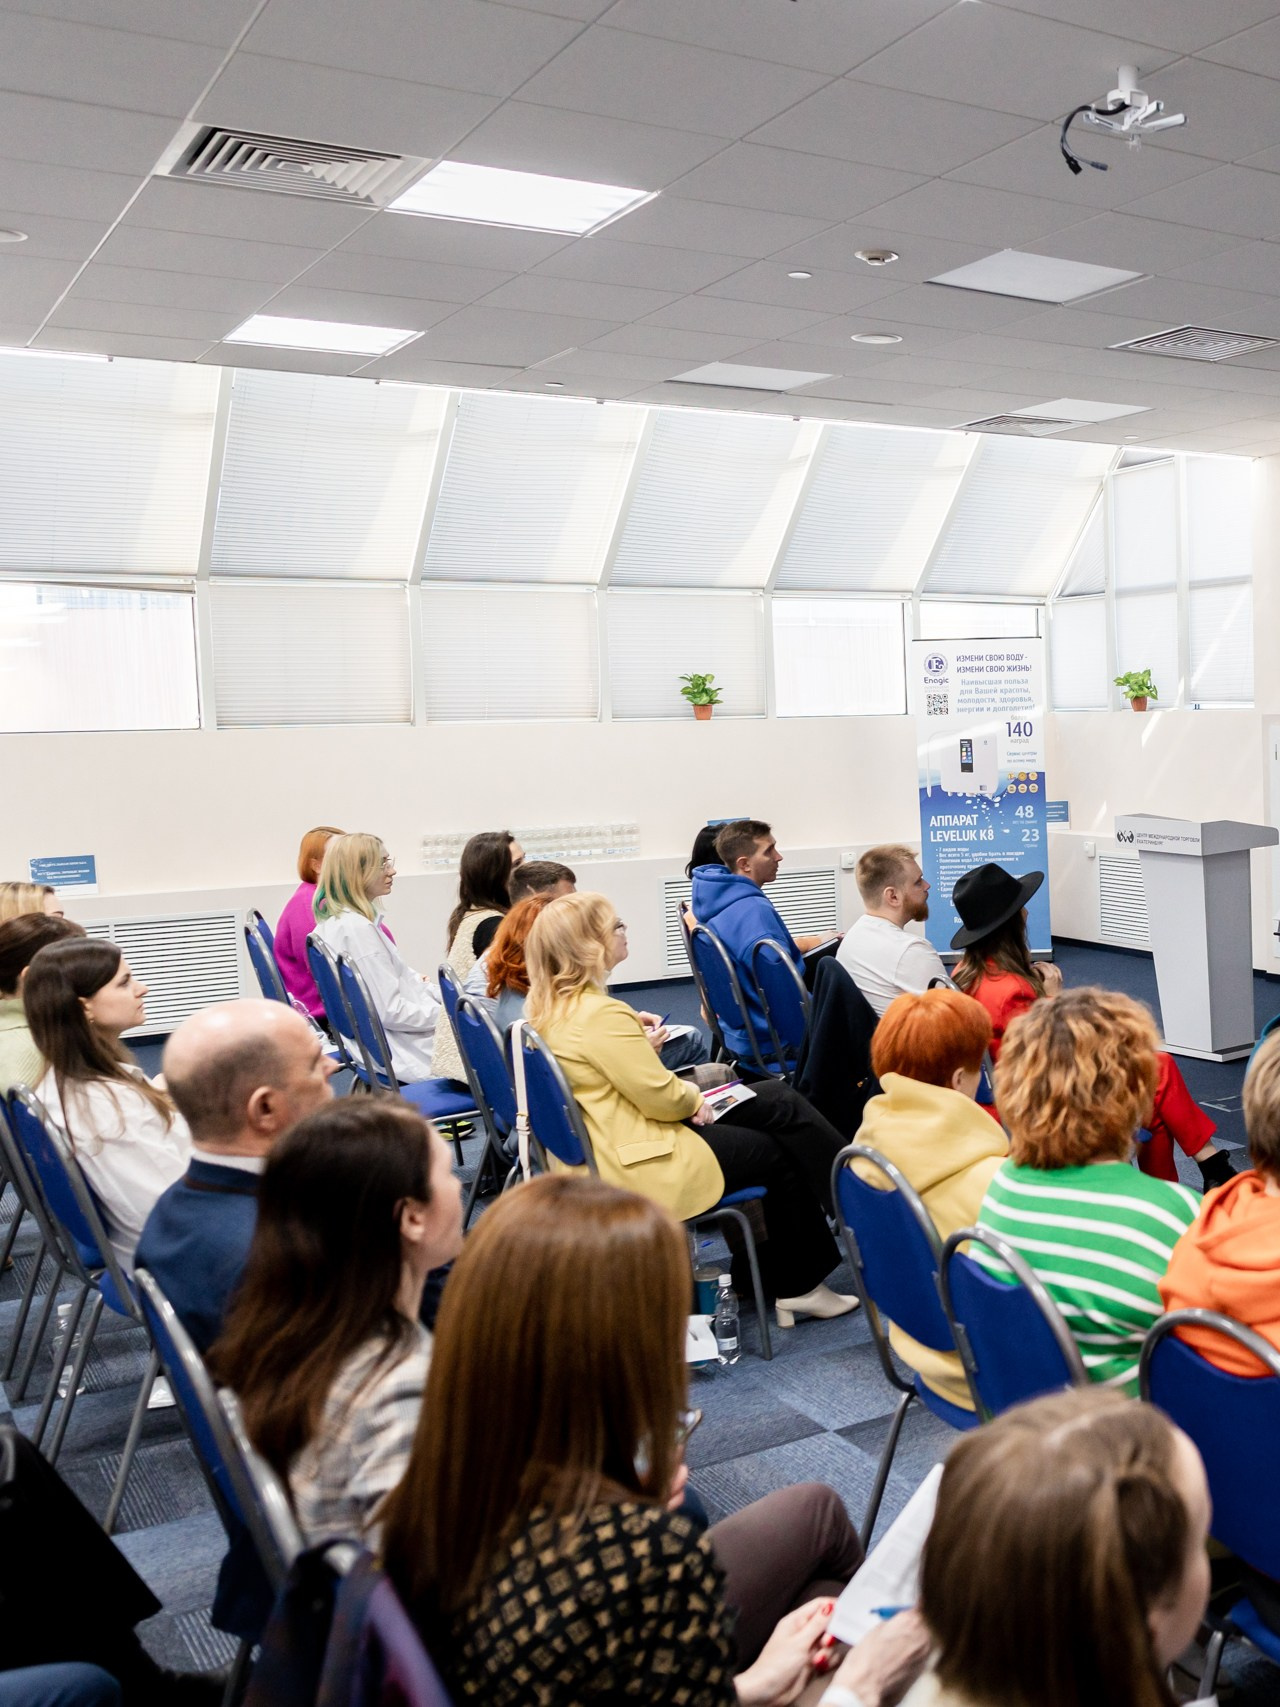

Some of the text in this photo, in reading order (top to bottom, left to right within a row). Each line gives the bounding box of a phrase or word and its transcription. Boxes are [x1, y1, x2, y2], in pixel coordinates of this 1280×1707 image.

[956, 654, 984, 662] ИЗМЕНИ
[985, 654, 1005, 662] СВОЮ
[1006, 653, 1024, 662] ВОДУ
[985, 665, 1005, 673] СВОЮ
[1006, 664, 1032, 672] ЖИЗНЬ!
[923, 676, 949, 686] Enagic
[959, 687, 1031, 696] для Вашей красоты,
[956, 706, 984, 714] энергии
[1005, 721, 1033, 737] 140
[1014, 804, 1034, 819] 48
[929, 814, 978, 827] АППАРАТ
[930, 829, 994, 842] LEVELUK K8
[1021, 828, 1040, 842] 23
